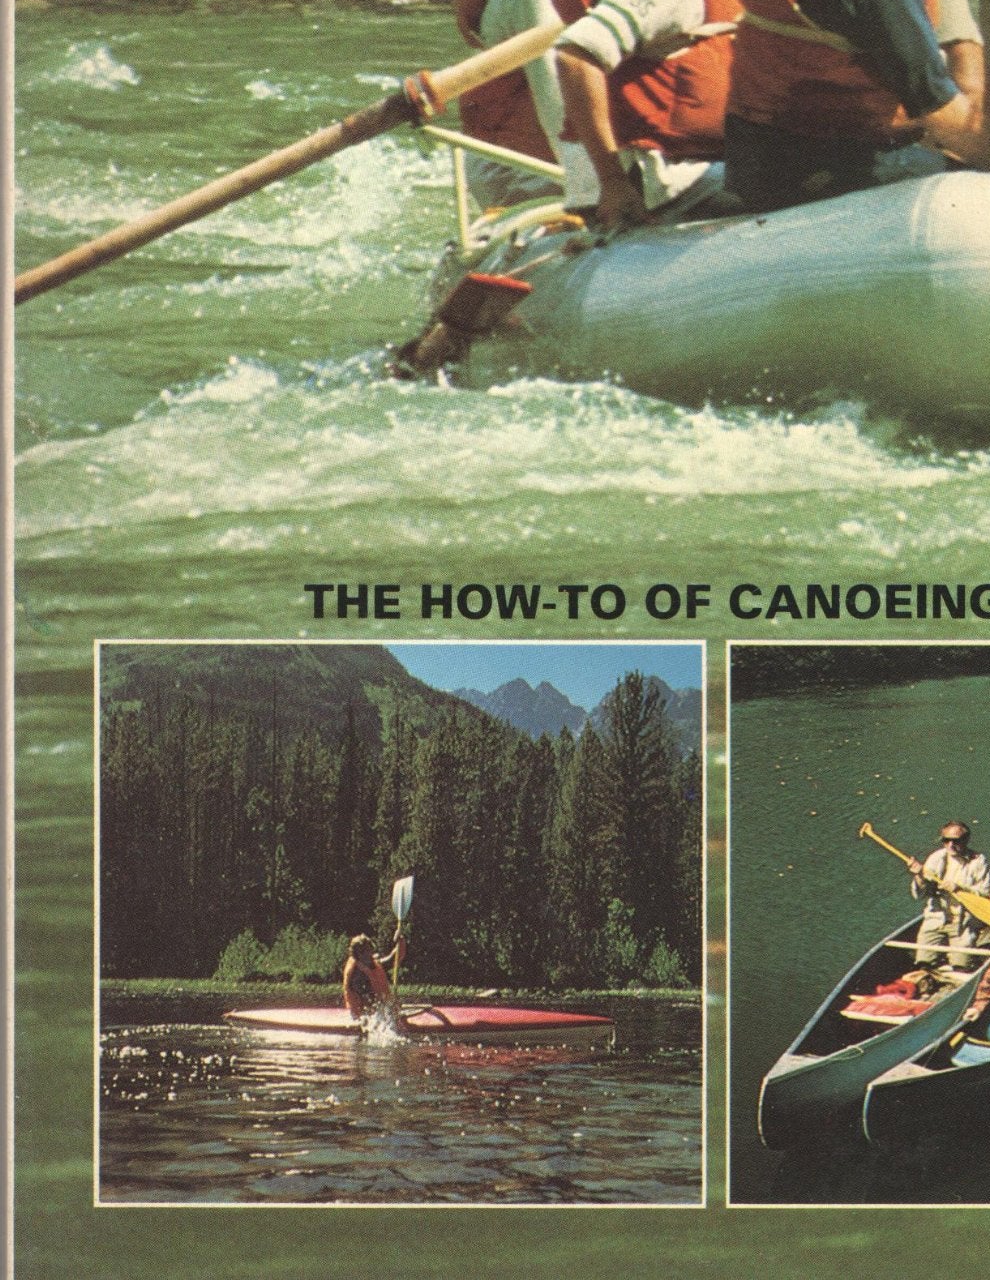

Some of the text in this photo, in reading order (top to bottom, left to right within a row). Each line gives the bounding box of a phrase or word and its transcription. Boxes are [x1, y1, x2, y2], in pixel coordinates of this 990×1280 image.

[304, 583, 400, 619] THE
[420, 583, 627, 620] HOW-TO
[644, 583, 711, 620] OF
